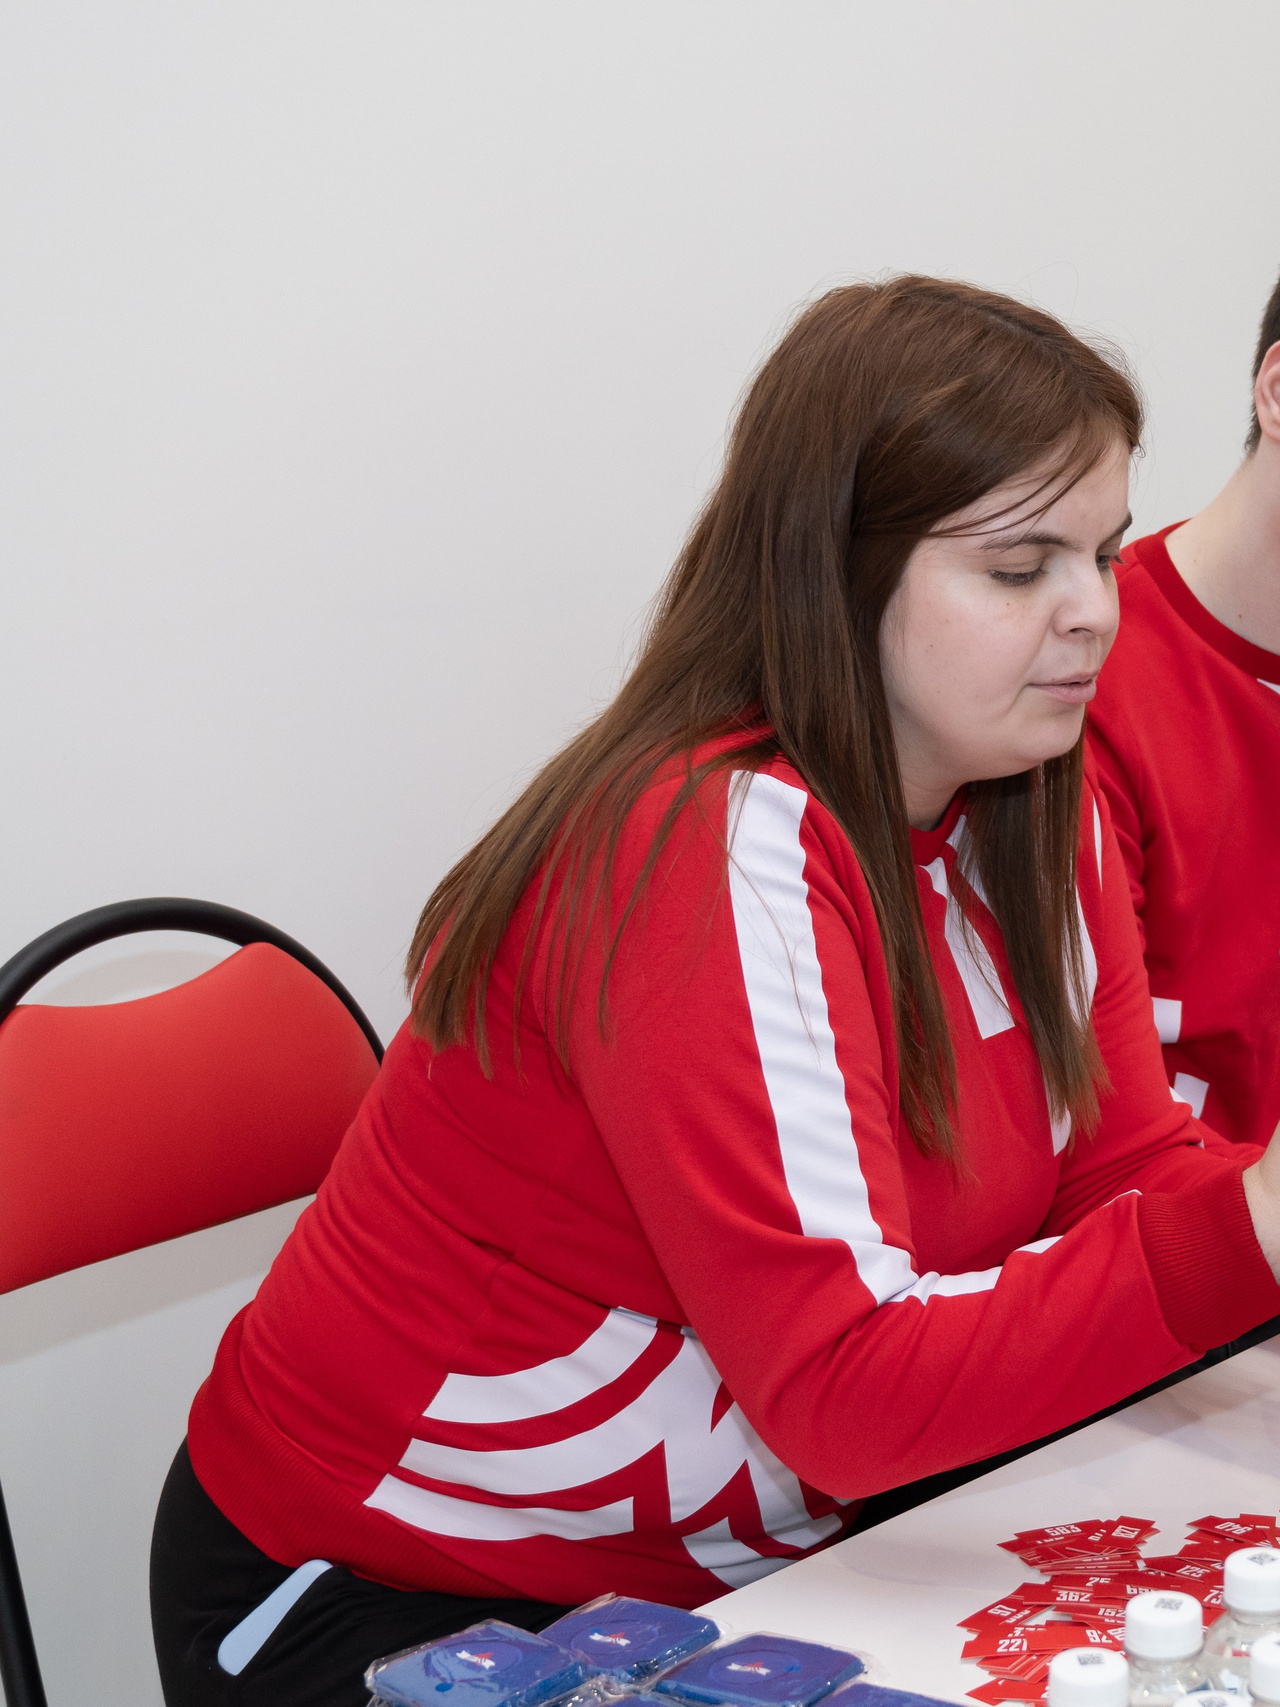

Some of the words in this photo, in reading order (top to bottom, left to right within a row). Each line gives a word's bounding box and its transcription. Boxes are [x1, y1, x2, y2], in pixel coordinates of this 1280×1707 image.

[1044, 1524, 1083, 1537] 583
[1175, 1564, 1211, 1579] 125
[1056, 1591, 1092, 1603] 362
